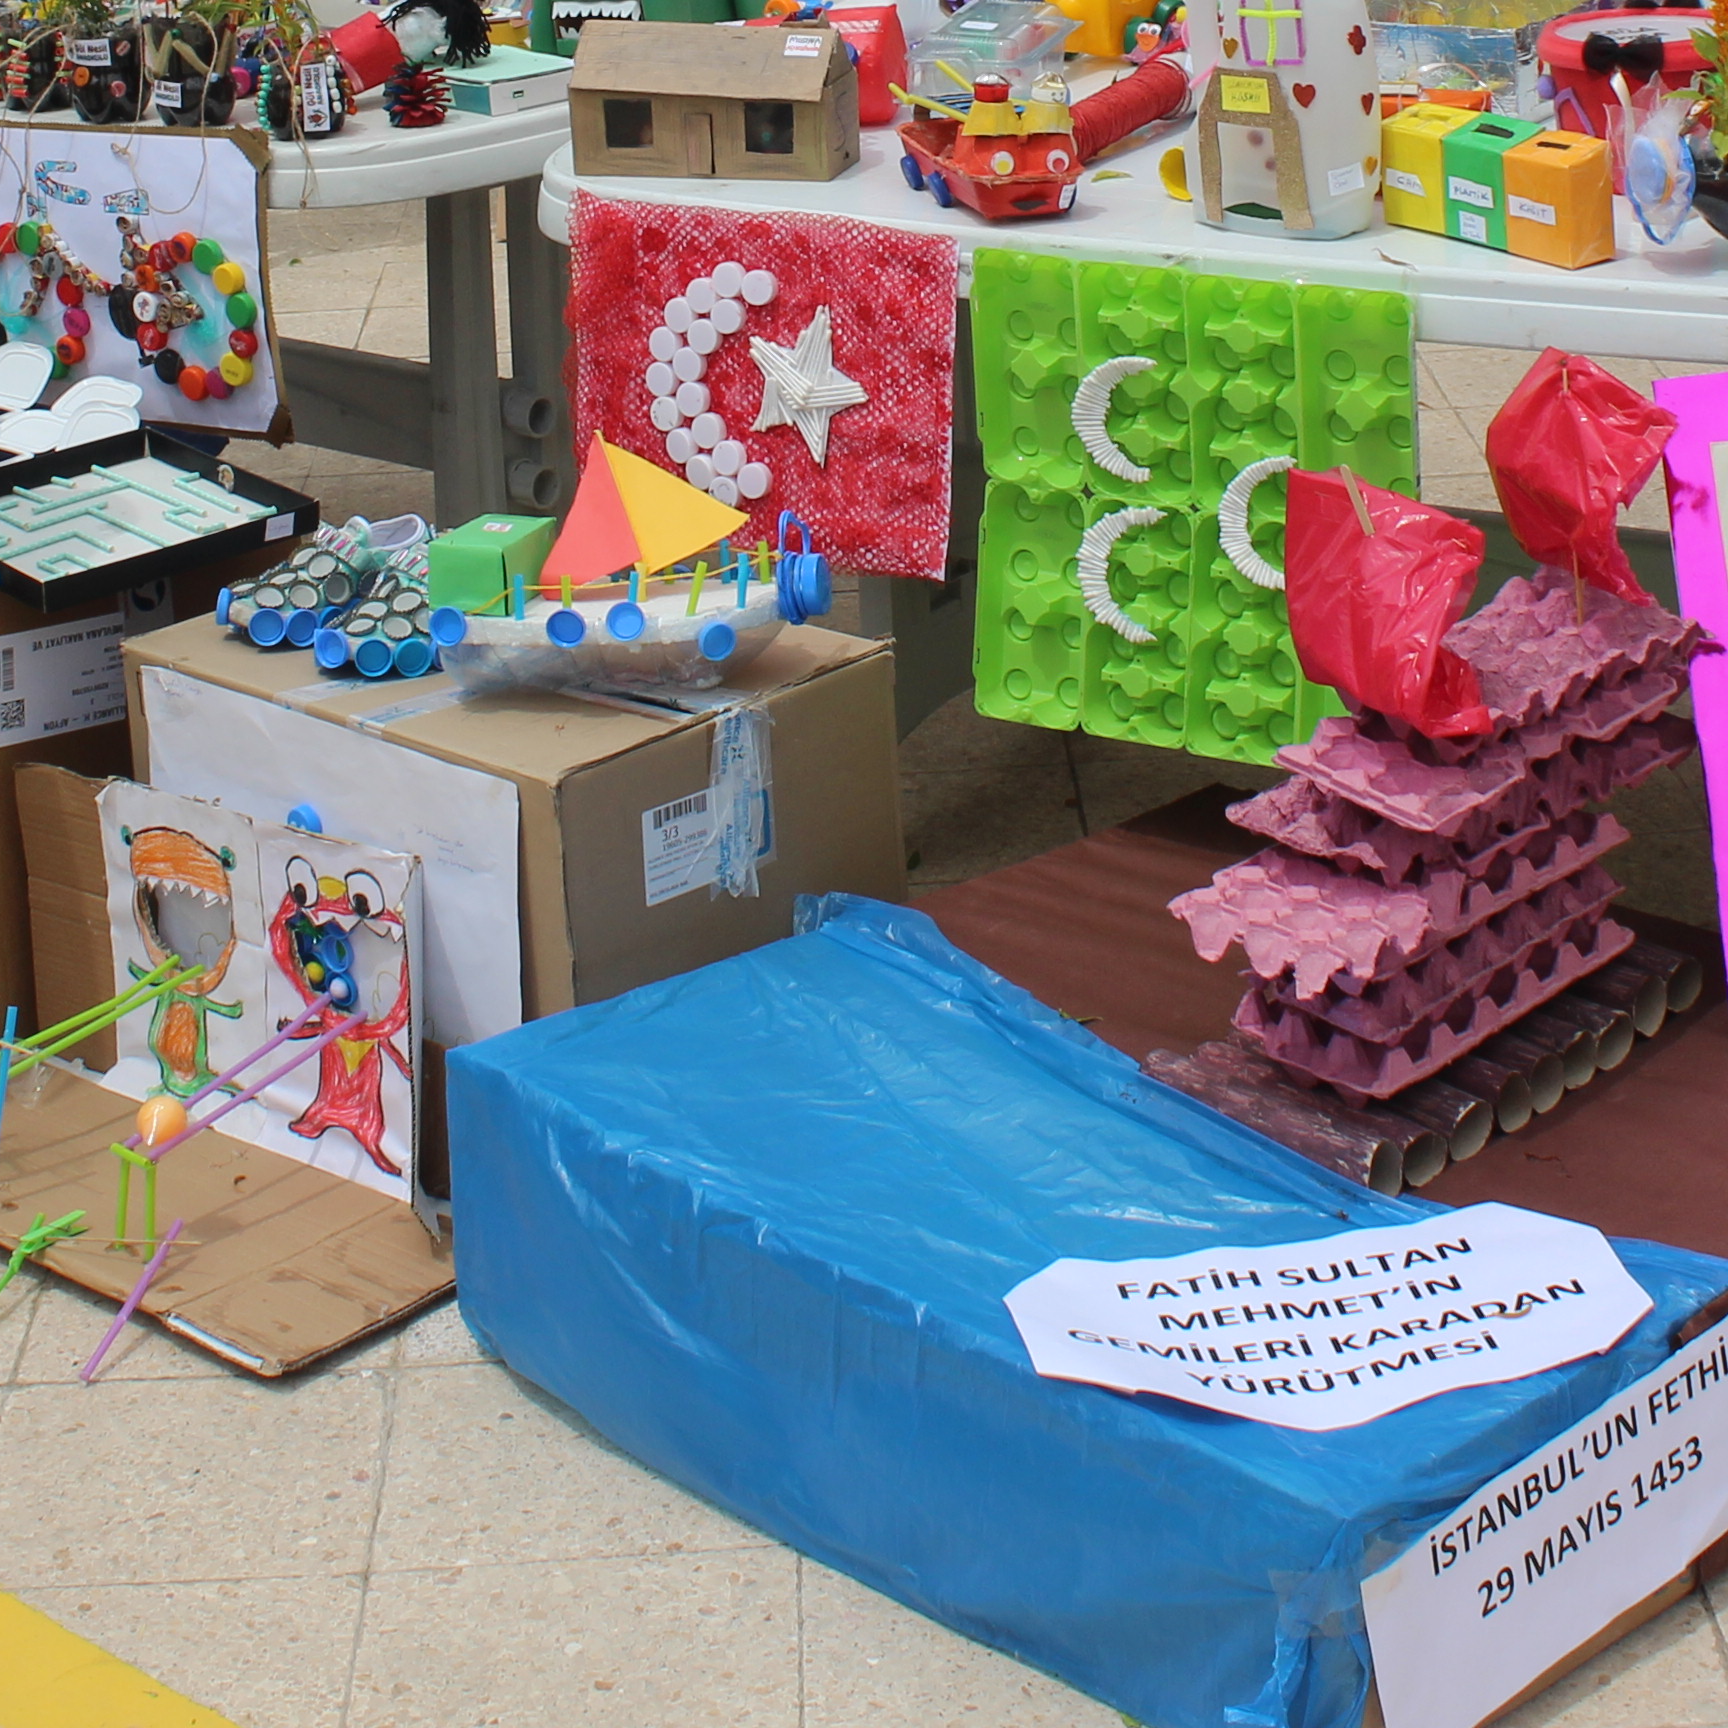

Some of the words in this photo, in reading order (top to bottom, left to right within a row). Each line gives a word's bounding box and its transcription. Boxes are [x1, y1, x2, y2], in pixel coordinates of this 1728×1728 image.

[661, 825, 679, 843] 3/3
[1115, 1267, 1262, 1301] FATİH
[1278, 1236, 1473, 1287] SULTAN
[1068, 1329, 1313, 1365] GEMİLERİ
[1329, 1278, 1586, 1353] KARADAN
[1186, 1330, 1501, 1396] YÜRÜTMESİ
[1477, 1566, 1515, 1618] 29
[1524, 1490, 1622, 1585] MAYIS
[1630, 1436, 1703, 1509] 1453
